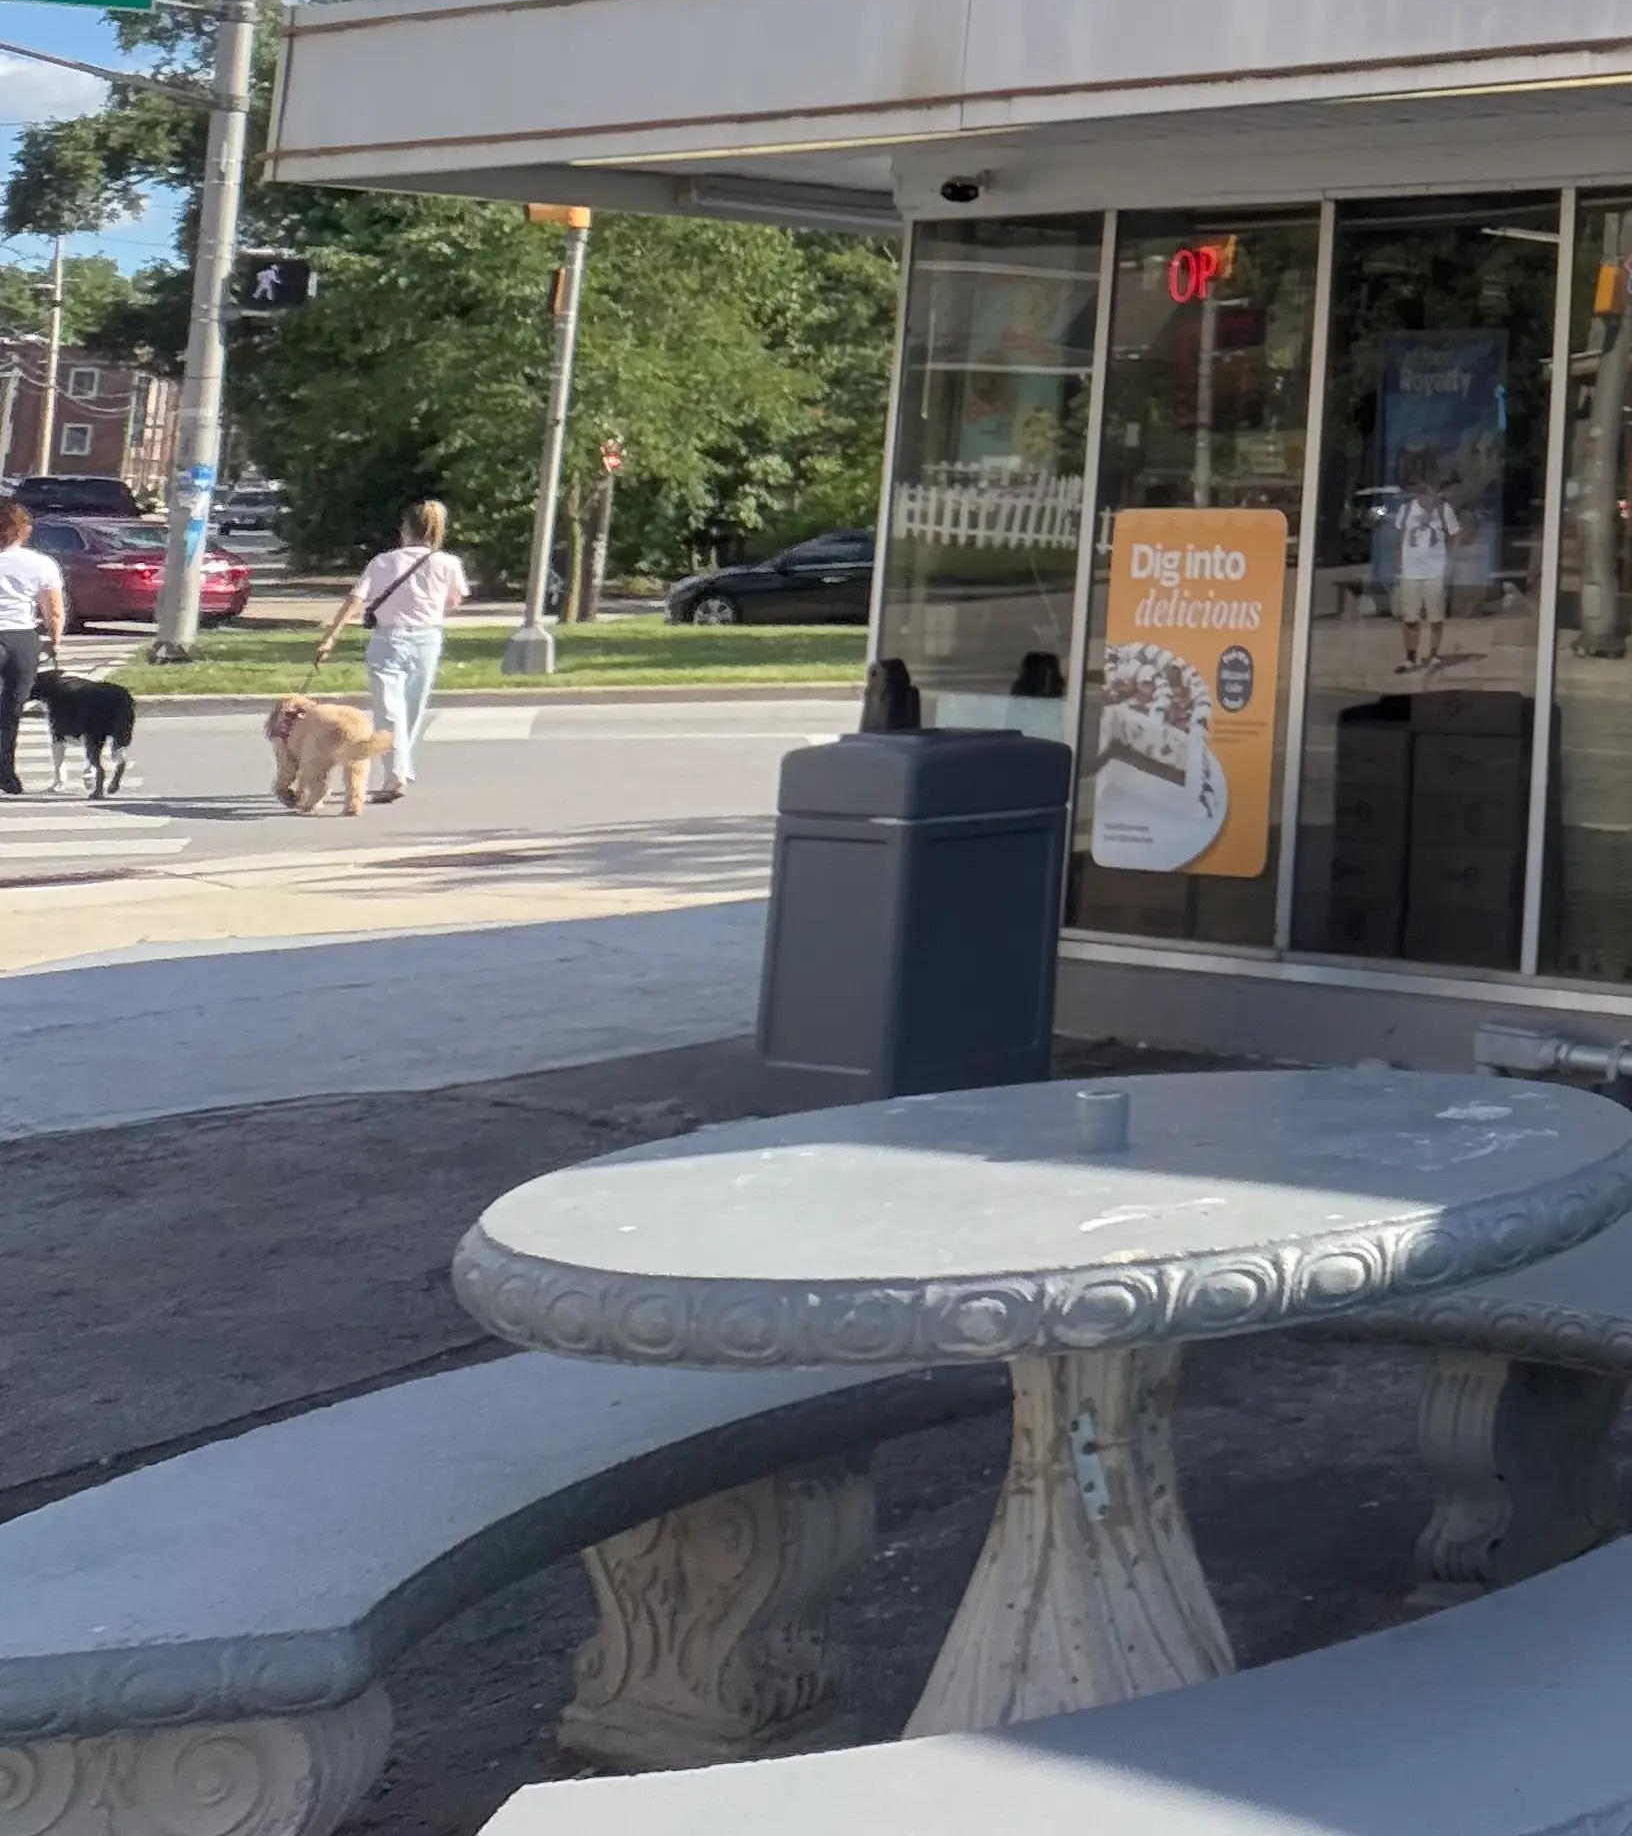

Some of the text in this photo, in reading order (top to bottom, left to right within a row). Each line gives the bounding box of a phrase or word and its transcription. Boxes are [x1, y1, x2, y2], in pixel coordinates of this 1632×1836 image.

[1399, 367, 1472, 399] Royalty
[1130, 542, 1247, 588] Dig into
[1134, 587, 1262, 632] delicious
